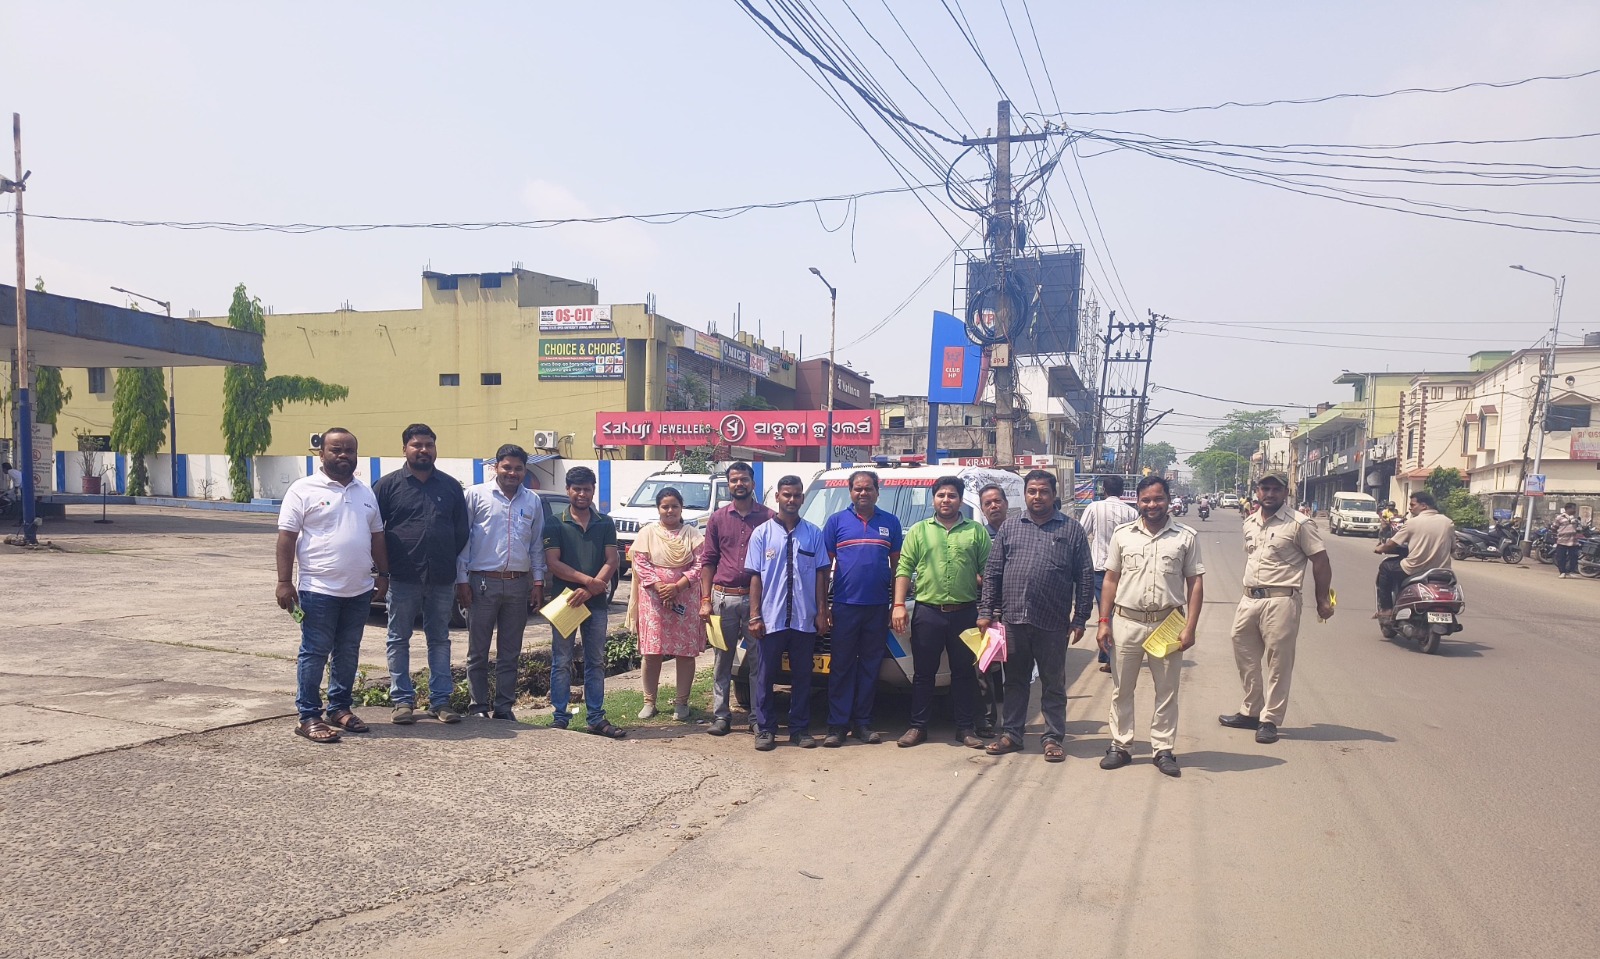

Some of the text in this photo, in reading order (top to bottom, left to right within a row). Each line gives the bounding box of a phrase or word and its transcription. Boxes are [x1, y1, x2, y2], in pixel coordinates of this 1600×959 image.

[555, 308, 593, 323] OS-CIT
[544, 342, 622, 356] CHOICE & CHOICE
[728, 345, 747, 363] NICE
[602, 421, 711, 440] Sahuji JEWELLERS
[965, 458, 991, 466] KIRAN
